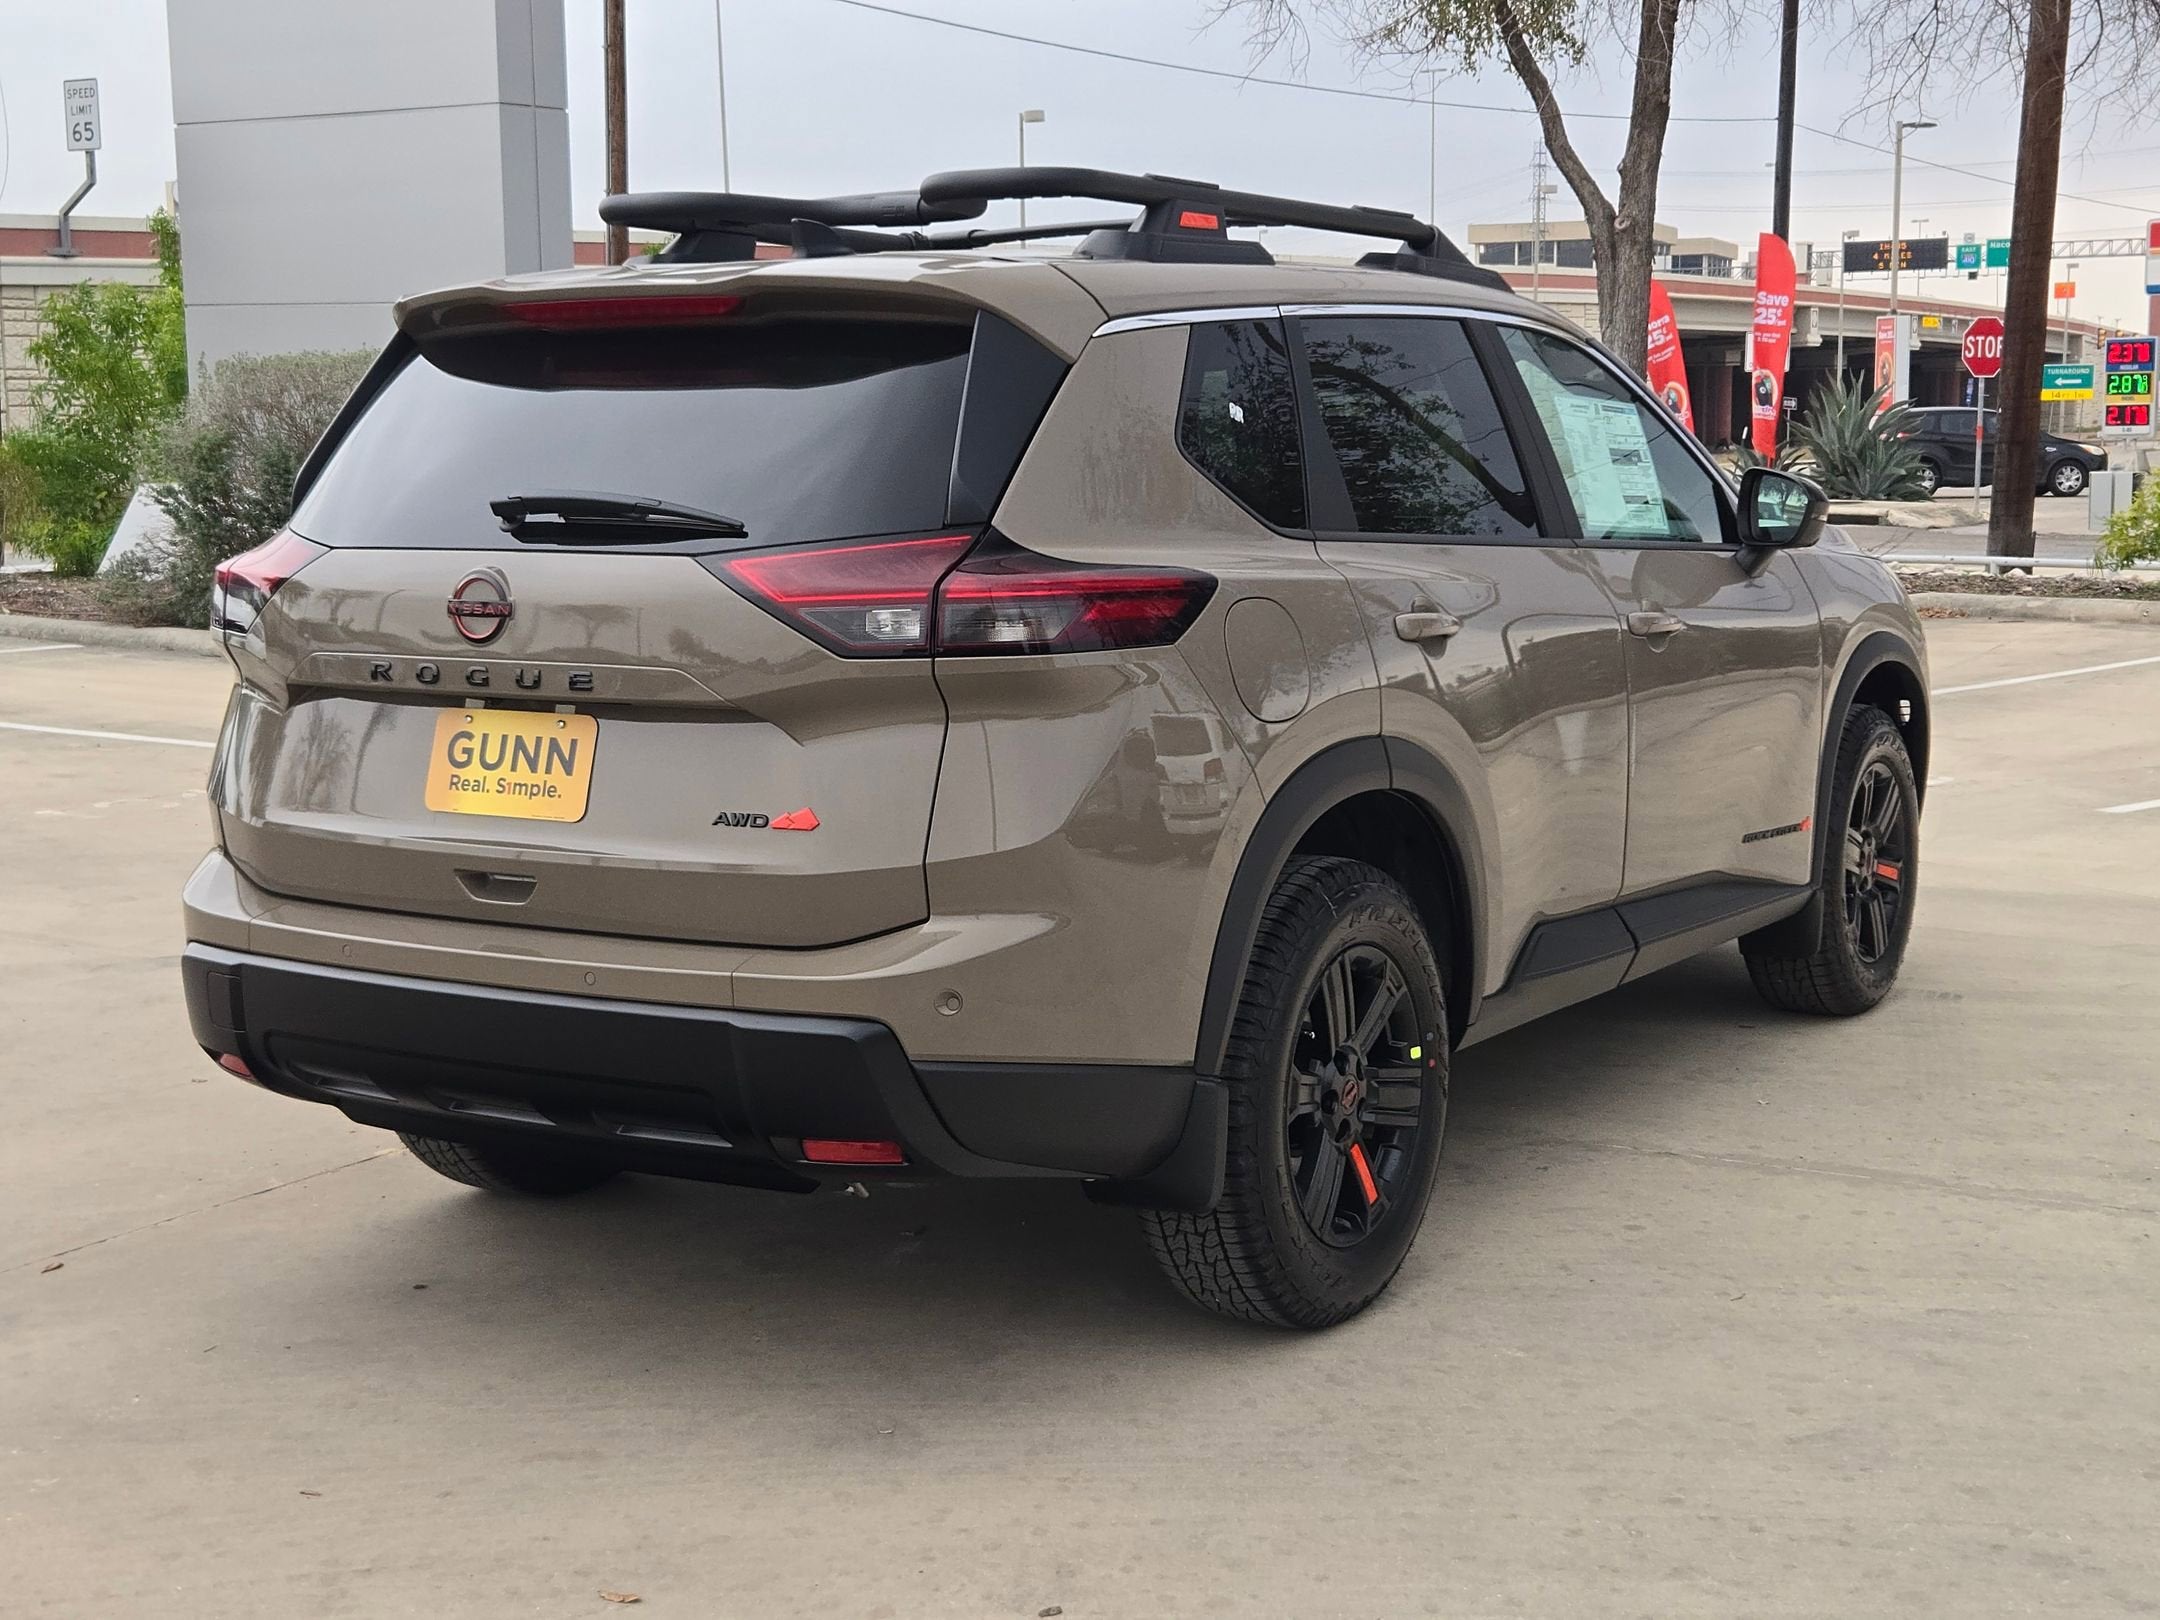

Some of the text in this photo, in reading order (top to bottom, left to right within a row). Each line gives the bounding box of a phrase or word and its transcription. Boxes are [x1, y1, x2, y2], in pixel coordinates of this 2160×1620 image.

[67, 88, 96, 100] SPEED
[71, 104, 93, 116] LIMIT
[73, 121, 95, 143] 65
[1756, 291, 1789, 307] Save
[449, 602, 510, 615] NSSAN
[370, 660, 595, 692] ROGUE
[447, 730, 578, 777] GUNN
[449, 774, 490, 793] Real.
[712, 812, 769, 828] AWD
